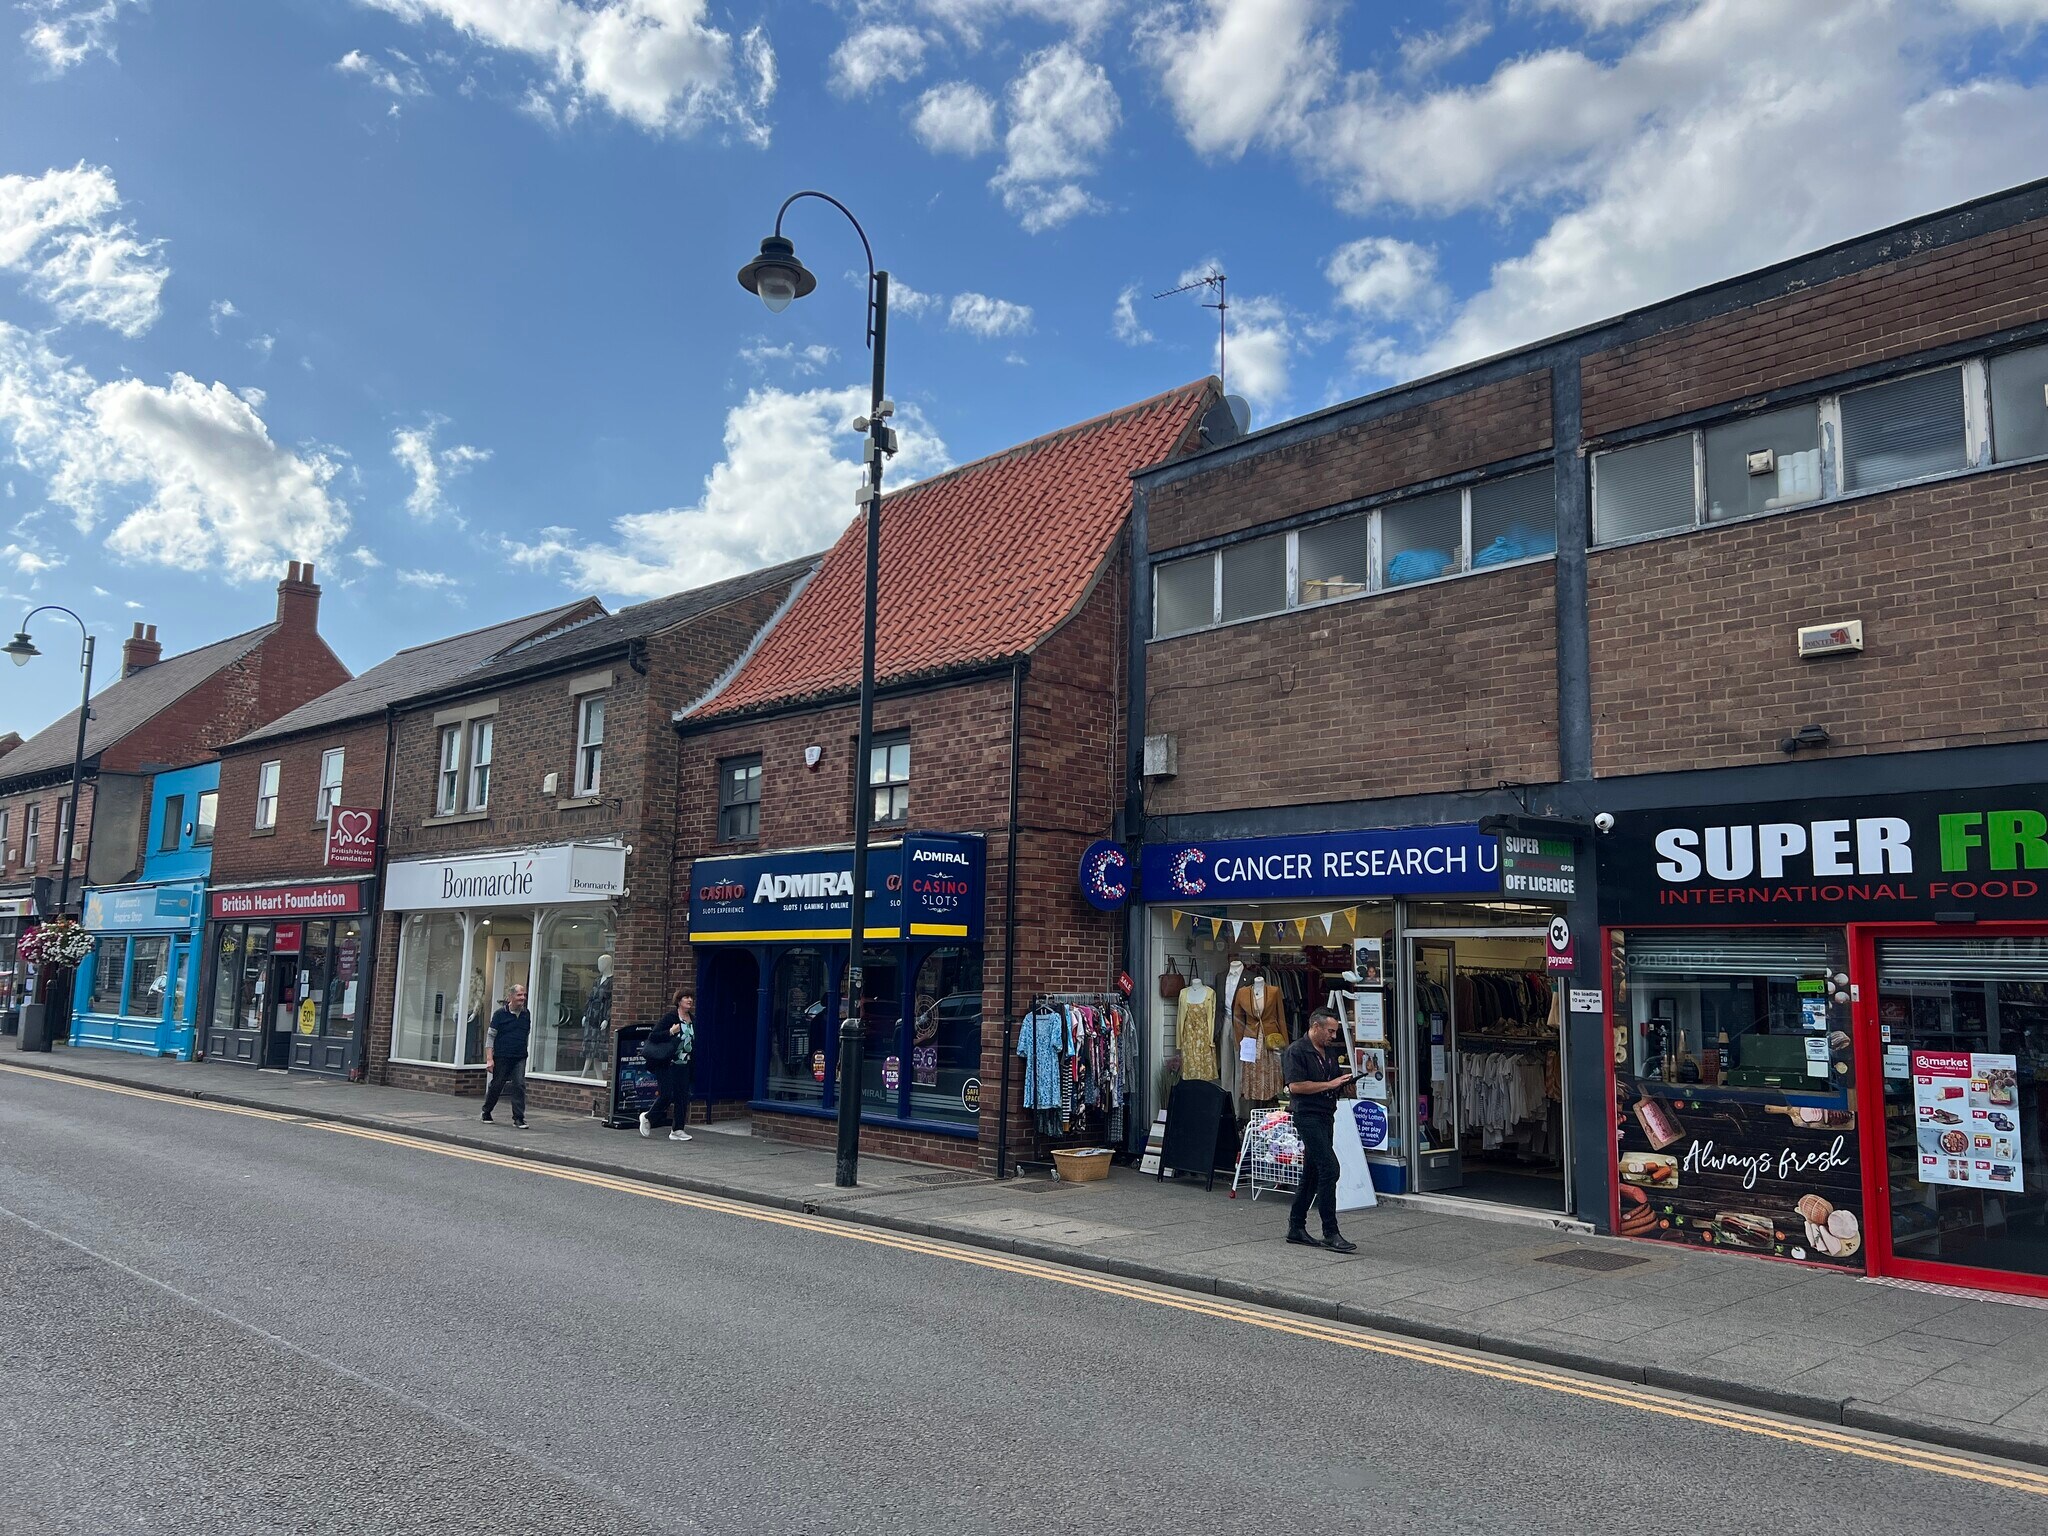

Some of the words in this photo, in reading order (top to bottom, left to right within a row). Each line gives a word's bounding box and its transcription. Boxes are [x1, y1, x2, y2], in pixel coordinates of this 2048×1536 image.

[1804, 638, 1834, 648] POINTER
[331, 847, 353, 855] British
[1505, 836, 1539, 855] SUPER
[1655, 817, 1913, 882] SUPER
[1938, 809, 2048, 873] FR
[331, 854, 372, 863] Foundation
[913, 849, 970, 865] ADMIRAL
[1214, 854, 1313, 883] CANCER
[1323, 845, 1467, 878] RESEARCH
[441, 860, 533, 899] Bonmarché
[573, 879, 618, 891] Bonmarché
[753, 871, 873, 904] ADMIRA
[912, 880, 968, 895] CASINO
[1505, 874, 1527, 890] OFF
[1528, 876, 1575, 894] LICENCE
[222, 896, 252, 912] British
[254, 893, 282, 910] Heart
[284, 889, 346, 908] Foundation
[700, 885, 745, 900] CASINO
[922, 894, 958, 906] SLOTS
[1659, 884, 1918, 905] INTERNATIONAL
[1929, 880, 2039, 899] FOOD
[717, 906, 745, 914] EXPERIENCE
[1549, 956, 1573, 965] payzone
[1683, 1139, 1773, 1190] Always
[1778, 1134, 1850, 1180] fresh
